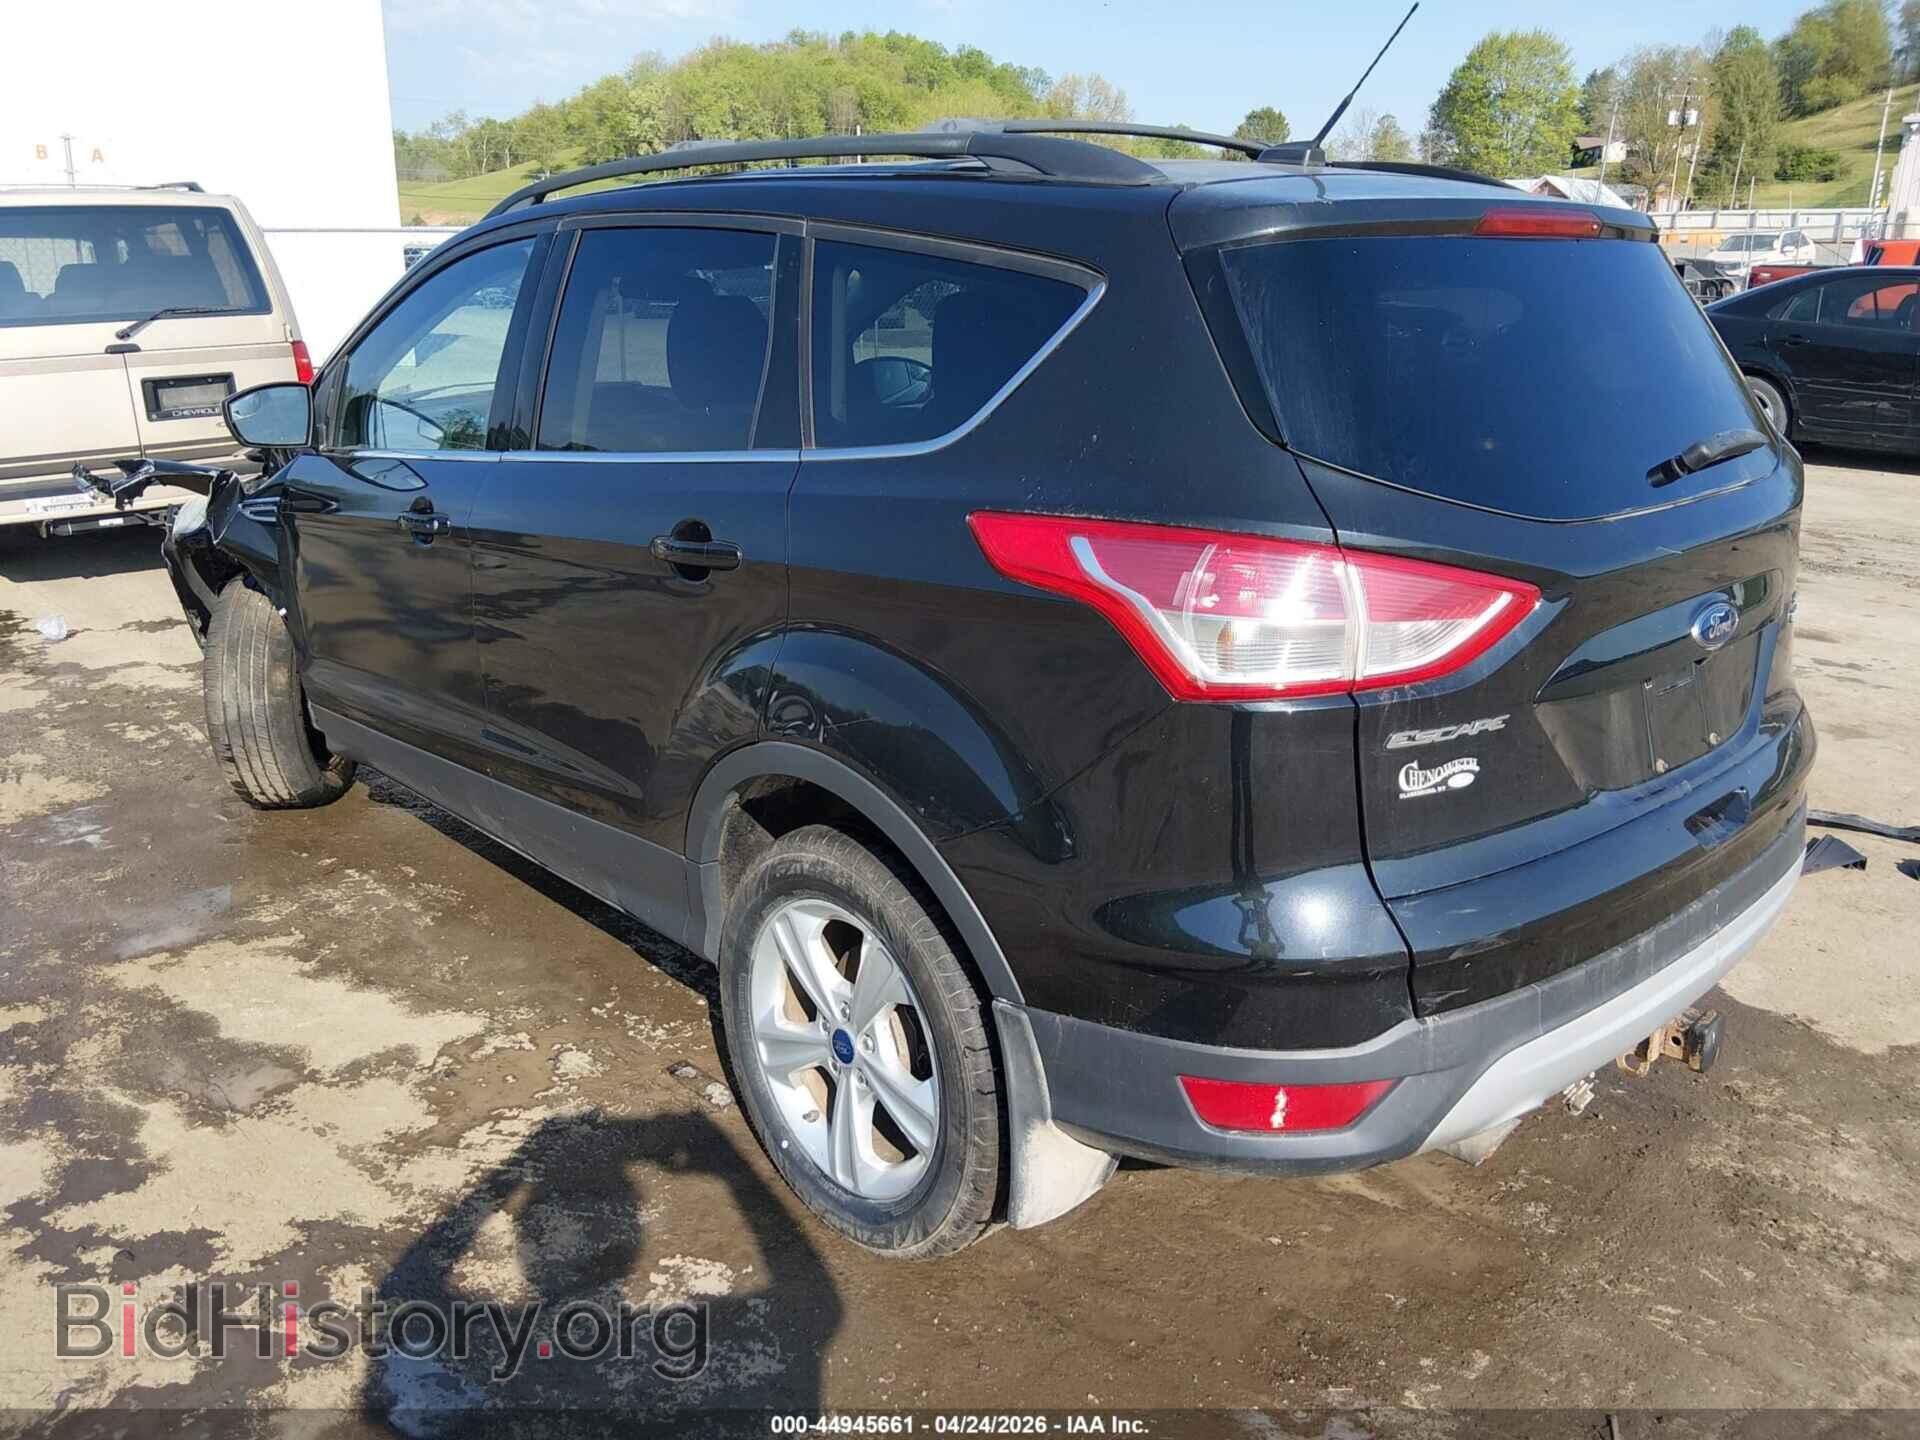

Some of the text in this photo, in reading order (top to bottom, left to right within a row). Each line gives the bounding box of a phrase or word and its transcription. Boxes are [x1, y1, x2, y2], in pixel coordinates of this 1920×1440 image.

[35, 143, 49, 160] B
[90, 147, 105, 163] A
[1385, 714, 1511, 750] ESCAPE
